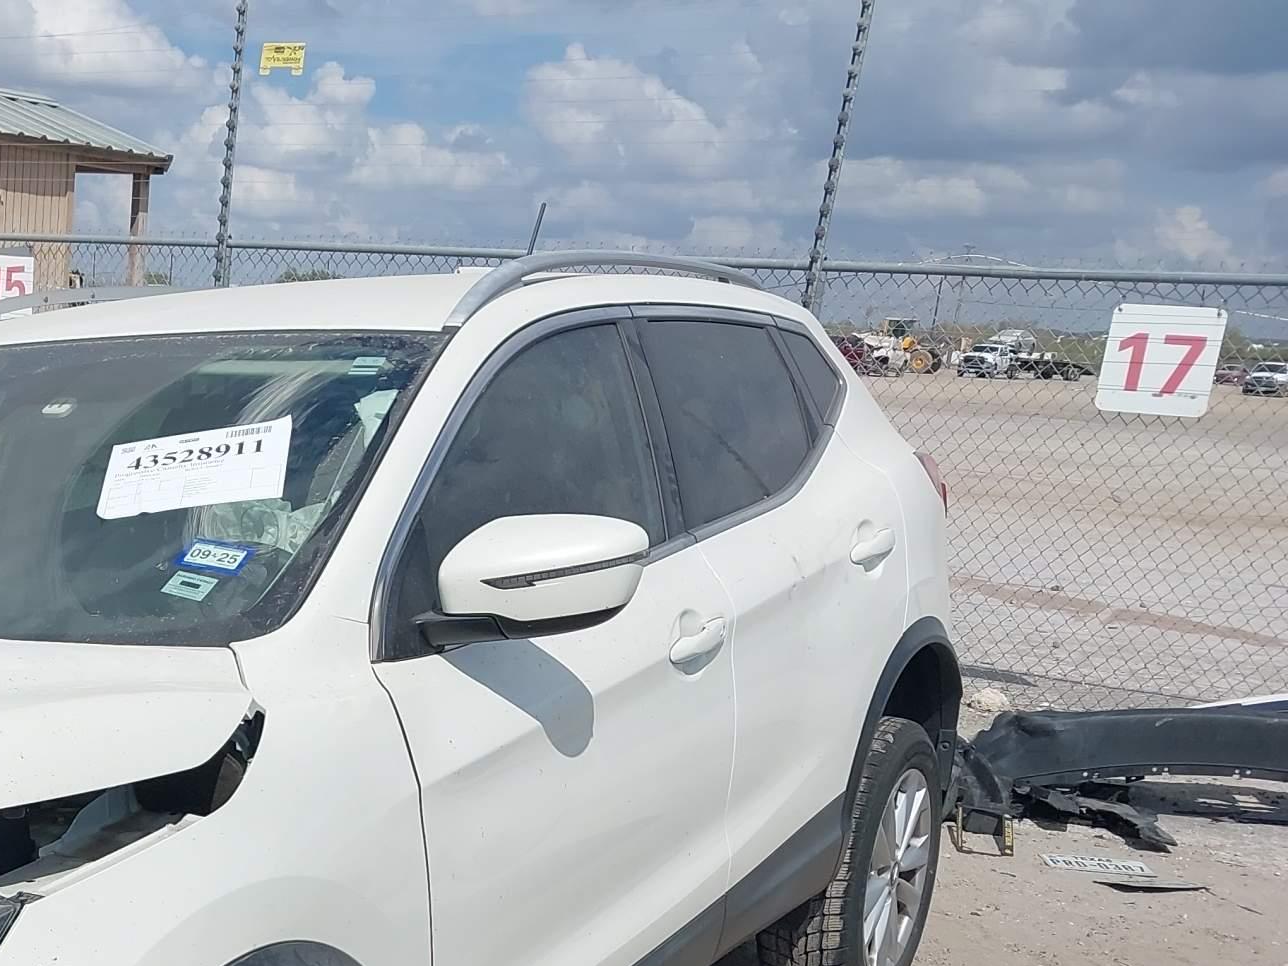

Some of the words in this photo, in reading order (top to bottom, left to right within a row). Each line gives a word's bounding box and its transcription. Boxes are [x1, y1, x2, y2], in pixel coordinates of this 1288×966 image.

[1117, 332, 1209, 395] 17
[127, 439, 264, 470] 43528911
[190, 548, 212, 560] 09
[216, 552, 240, 564] 25
